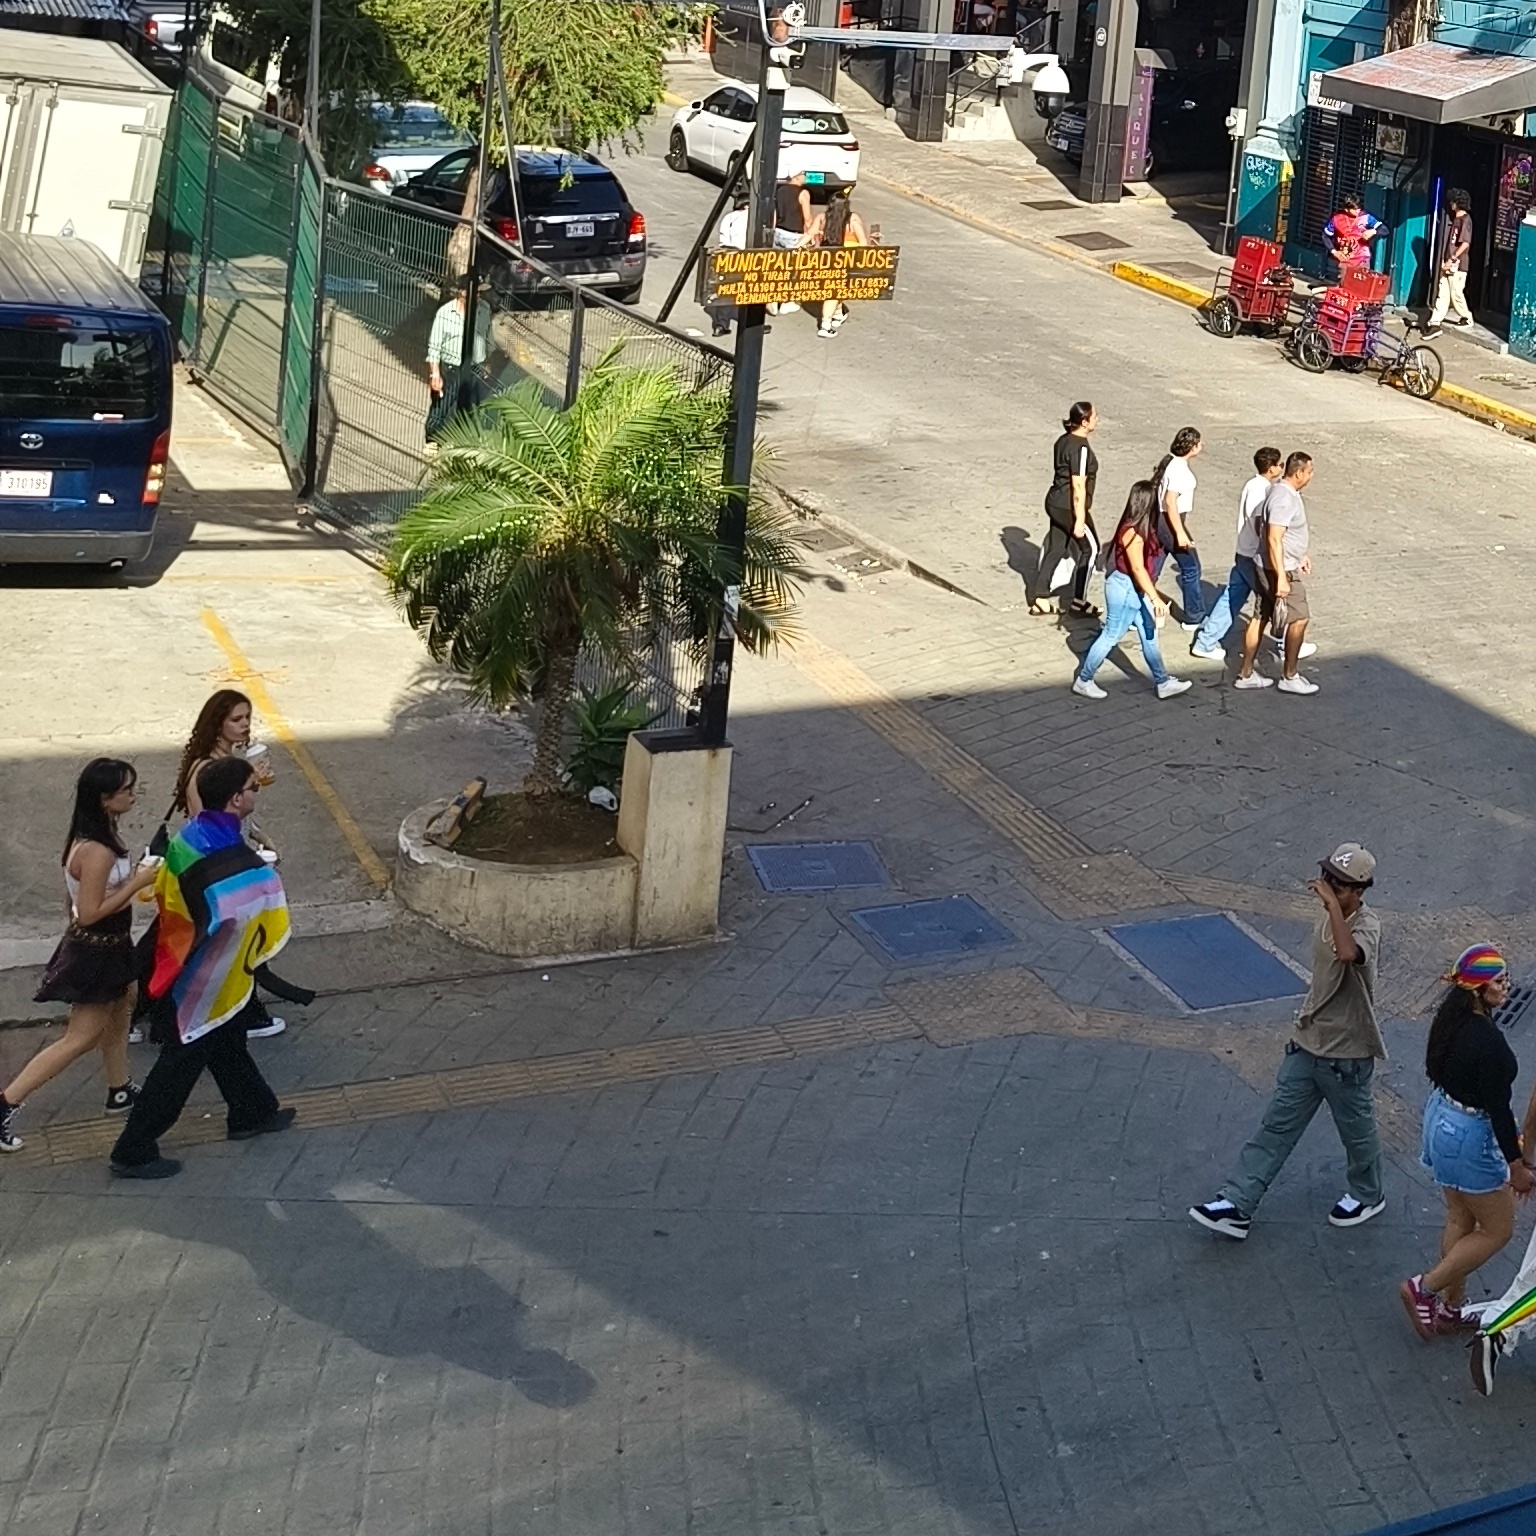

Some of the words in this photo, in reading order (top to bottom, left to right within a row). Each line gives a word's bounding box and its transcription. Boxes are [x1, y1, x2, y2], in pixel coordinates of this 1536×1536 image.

[715, 249, 831, 273] MUNICIPALIDAD
[834, 249, 856, 269] SN
[856, 249, 896, 269] JOSE
